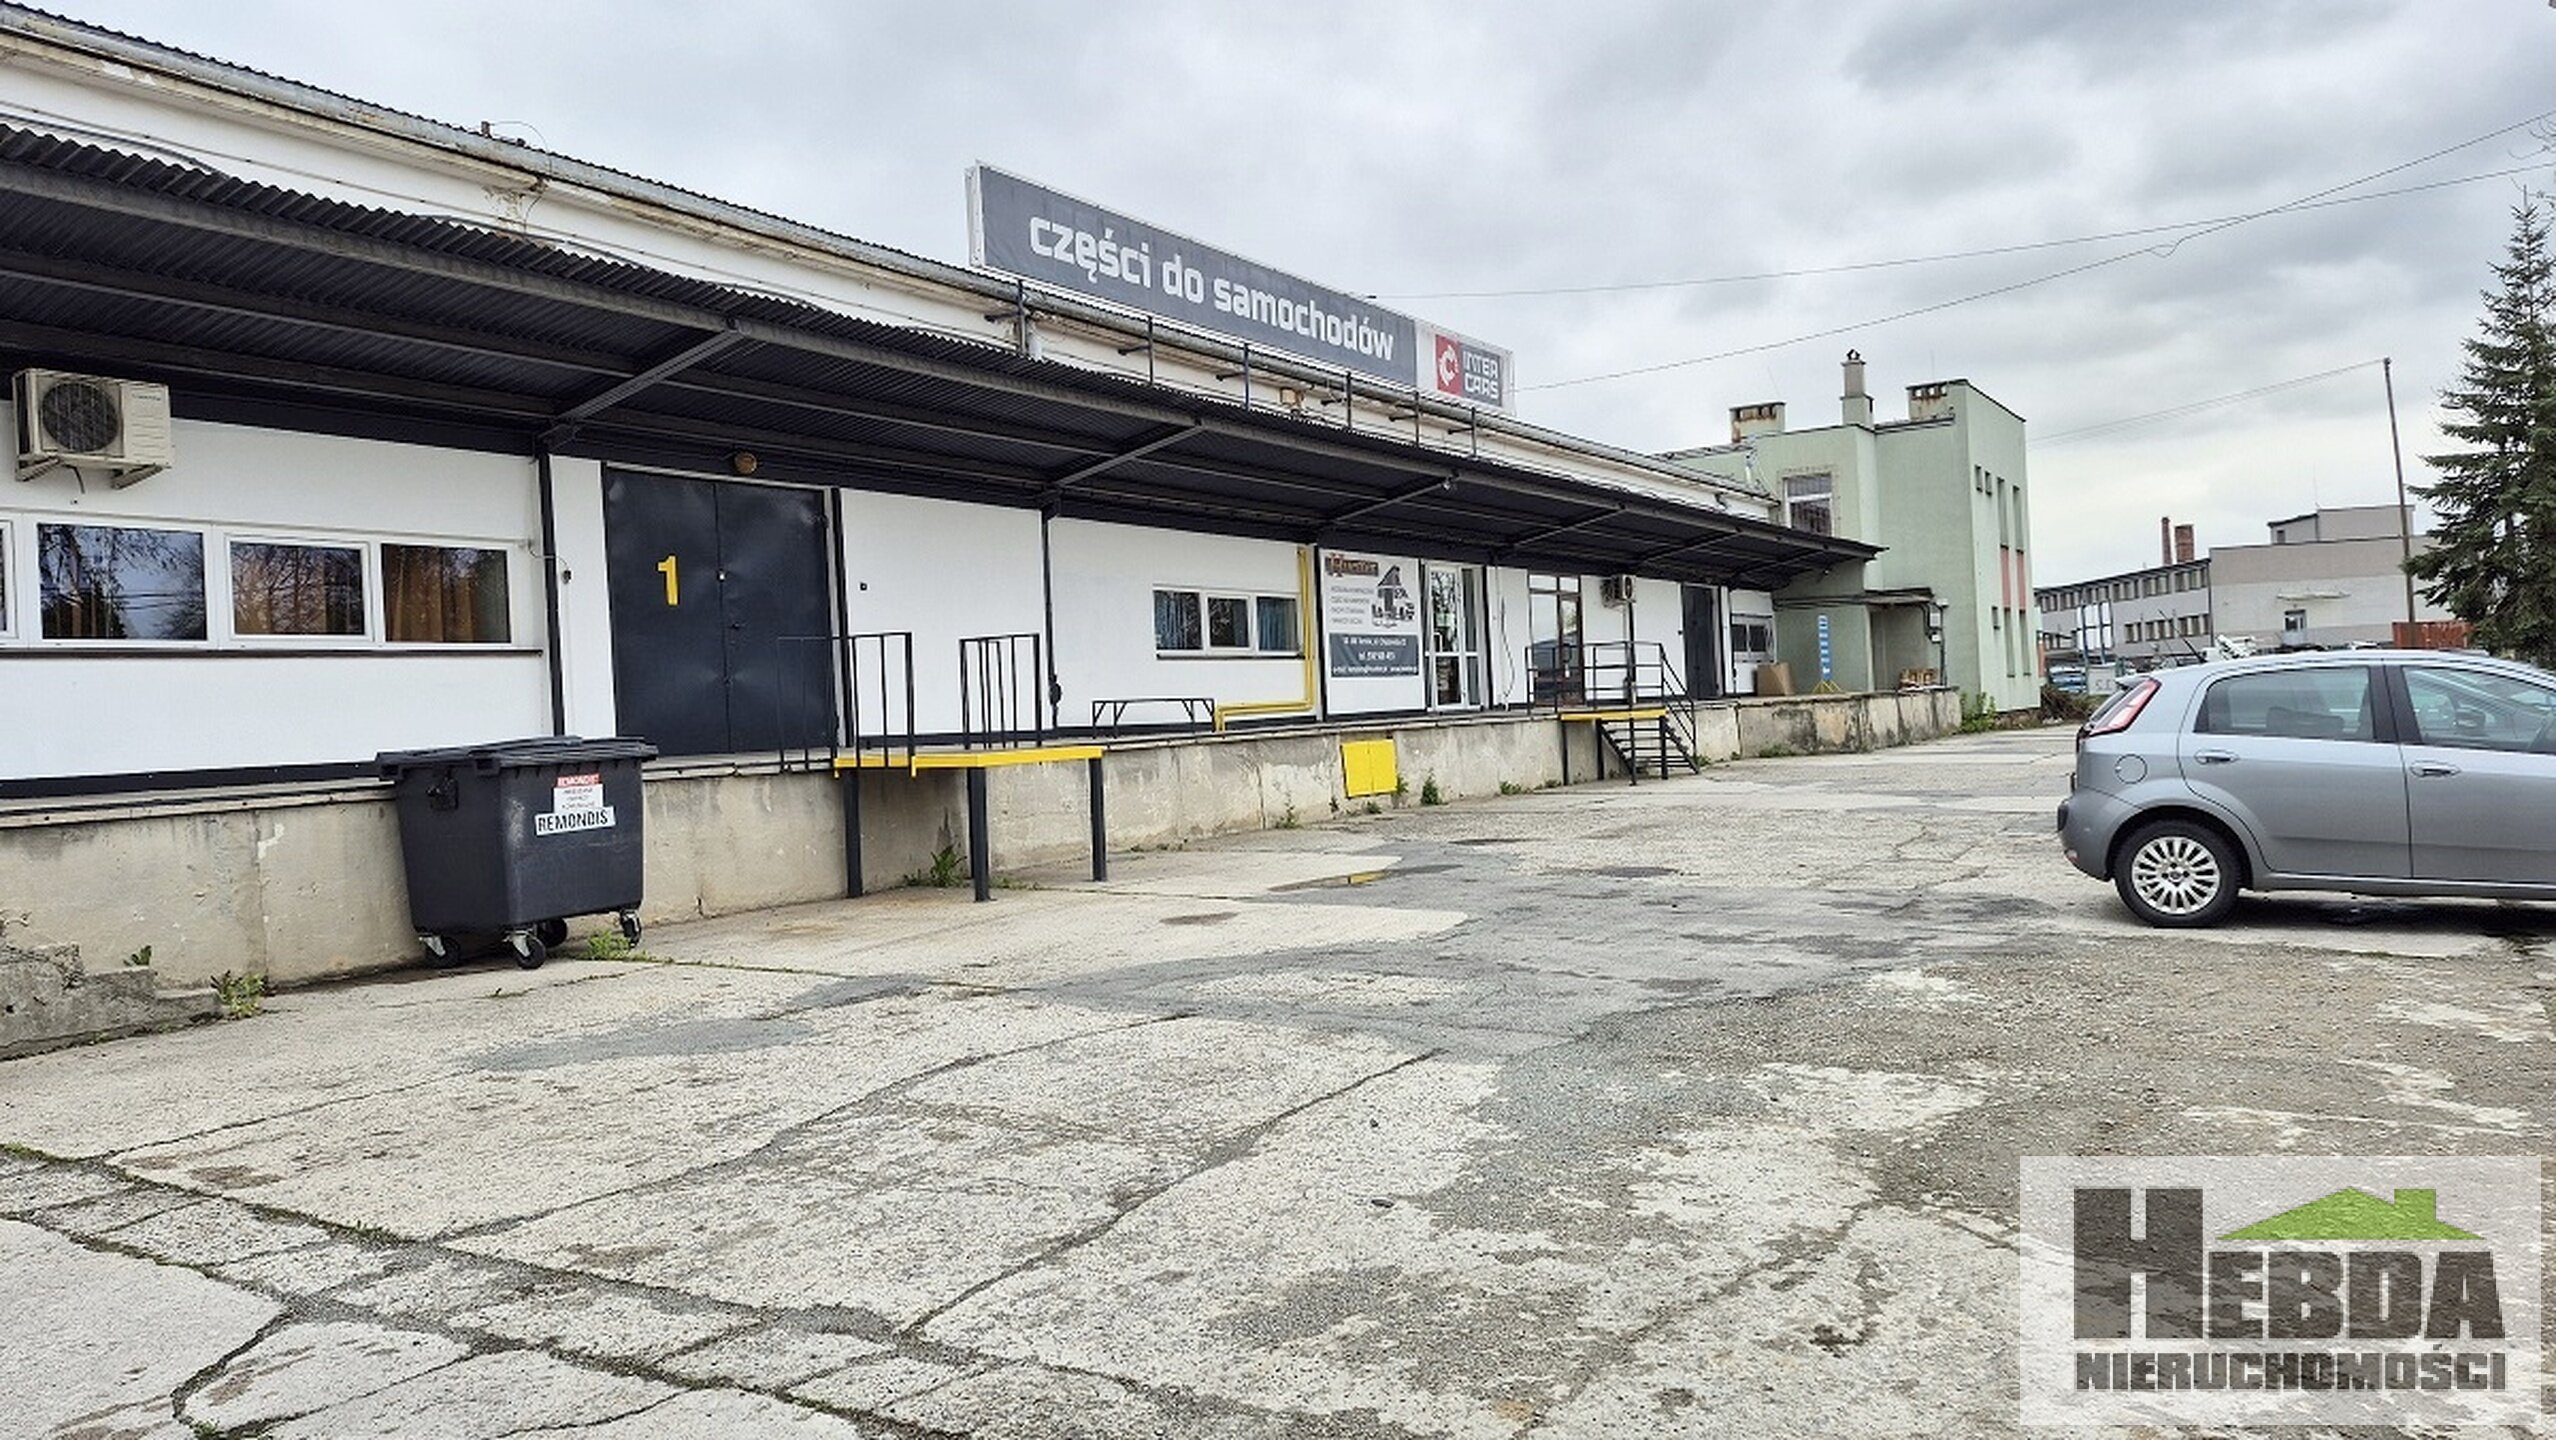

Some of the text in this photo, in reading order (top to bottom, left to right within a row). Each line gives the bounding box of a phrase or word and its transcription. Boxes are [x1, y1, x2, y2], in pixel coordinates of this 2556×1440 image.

[1029, 215, 1395, 362] części do samochodów
[1462, 350, 1499, 379] INTER
[1464, 373, 1499, 400] CARS
[656, 554, 679, 605] 1
[538, 808, 608, 832] REMONDIS
